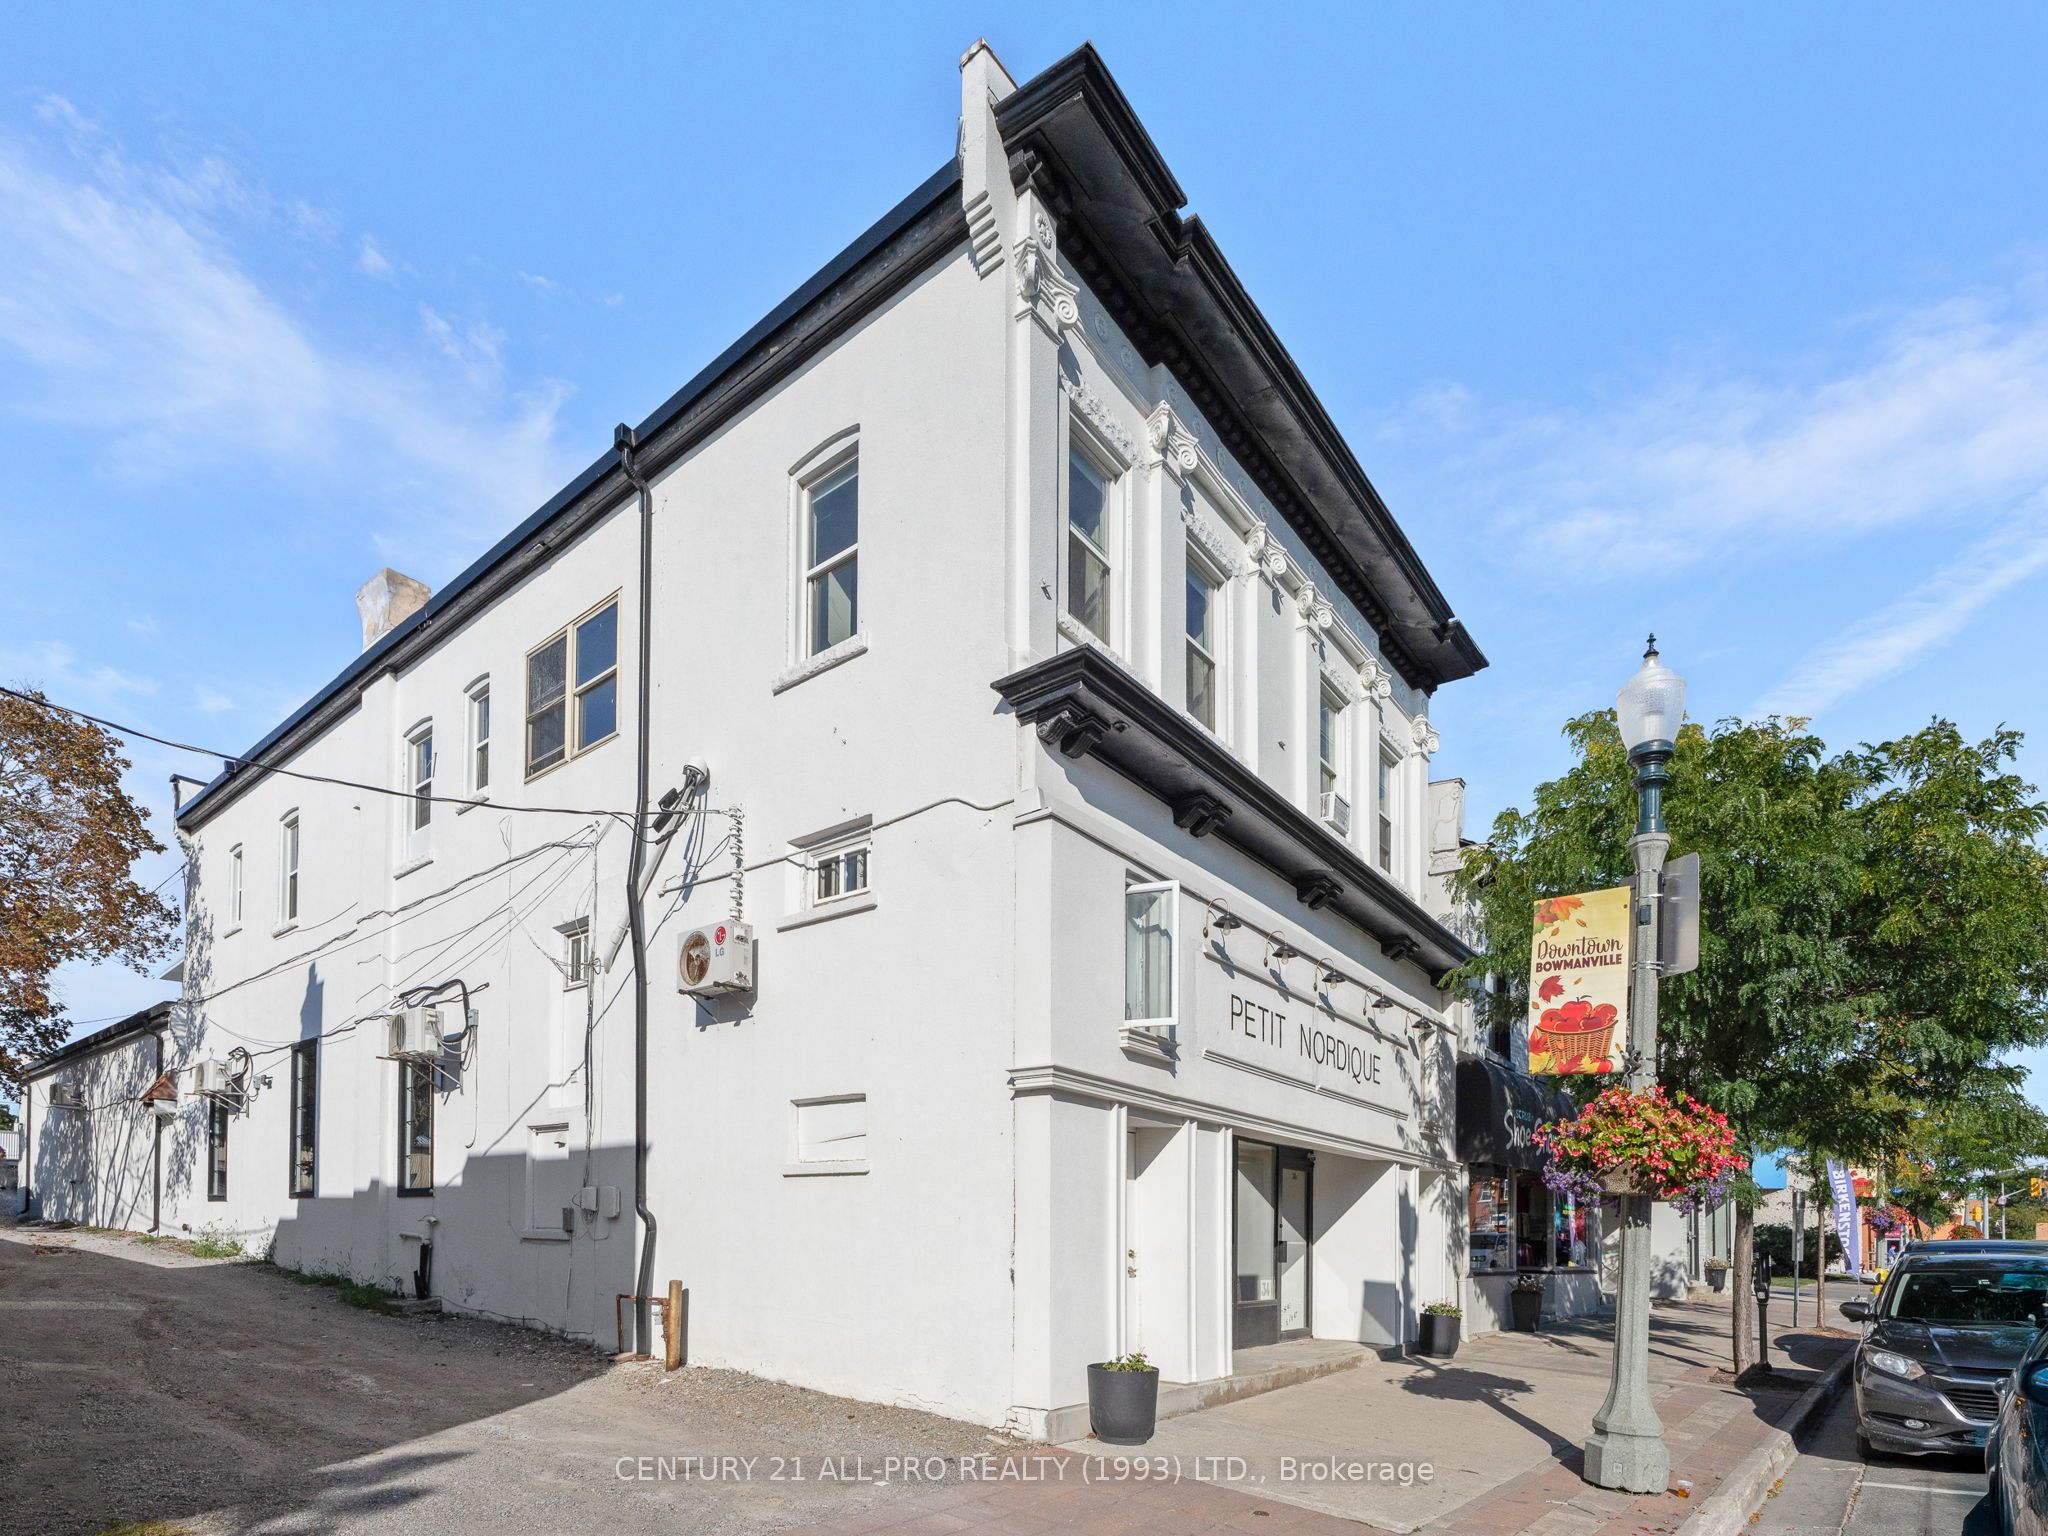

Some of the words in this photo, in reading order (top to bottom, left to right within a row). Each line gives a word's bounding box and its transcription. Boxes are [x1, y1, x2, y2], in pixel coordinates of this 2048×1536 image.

[715, 947, 725, 957] LG
[1537, 936, 1623, 960] Downtown
[1535, 954, 1622, 973] BOWMANVILLE
[1230, 993, 1286, 1049] PETIT
[1300, 1023, 1381, 1085] NORDIQUE
[1503, 1108, 1532, 1150] Shoe
